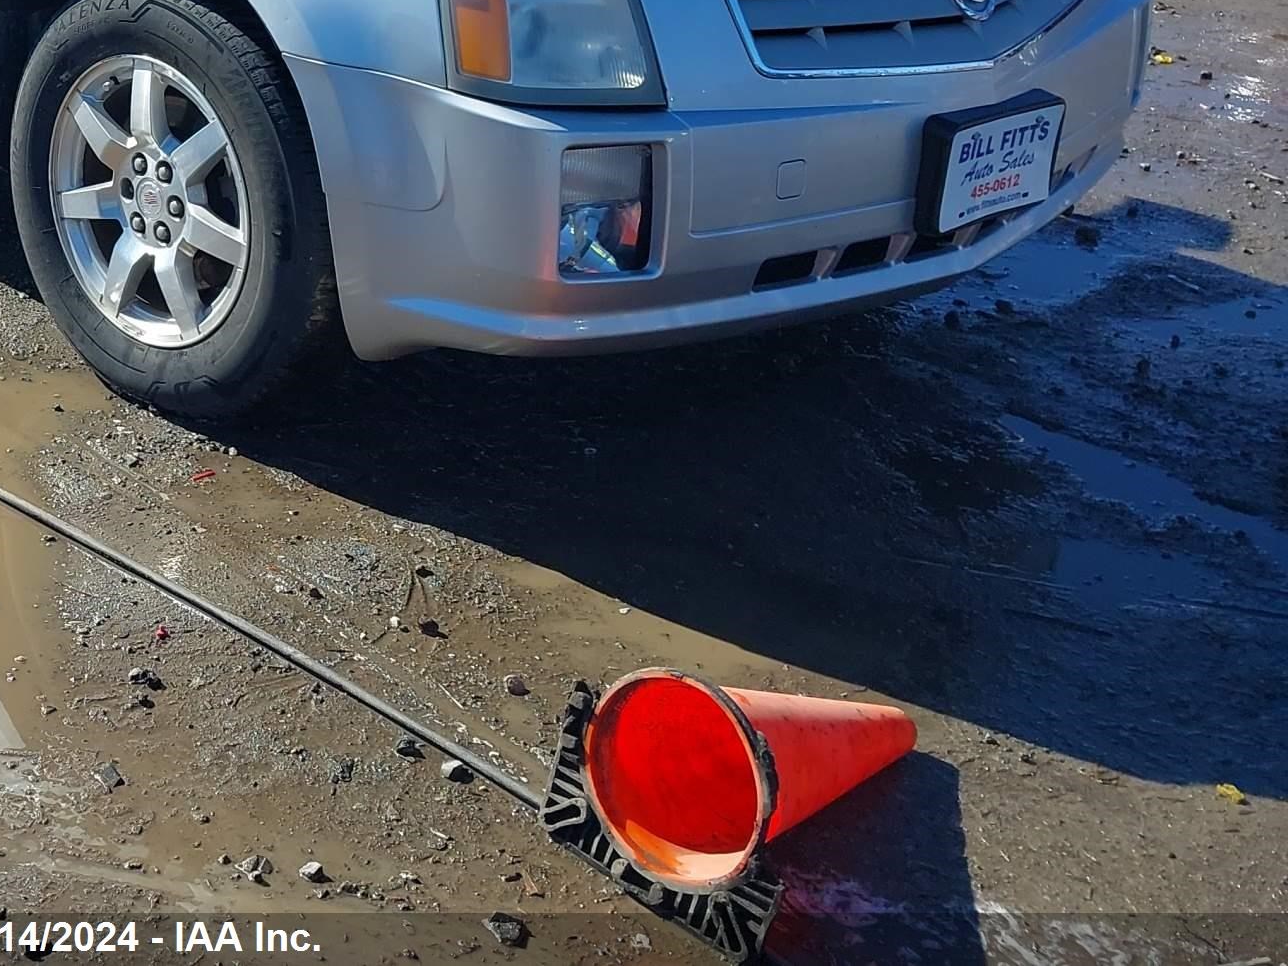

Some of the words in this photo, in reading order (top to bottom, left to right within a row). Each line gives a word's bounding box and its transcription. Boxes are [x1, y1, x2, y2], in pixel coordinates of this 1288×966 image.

[958, 133, 994, 164] BILL
[961, 160, 994, 187] Auto
[998, 149, 1035, 174] Sales
